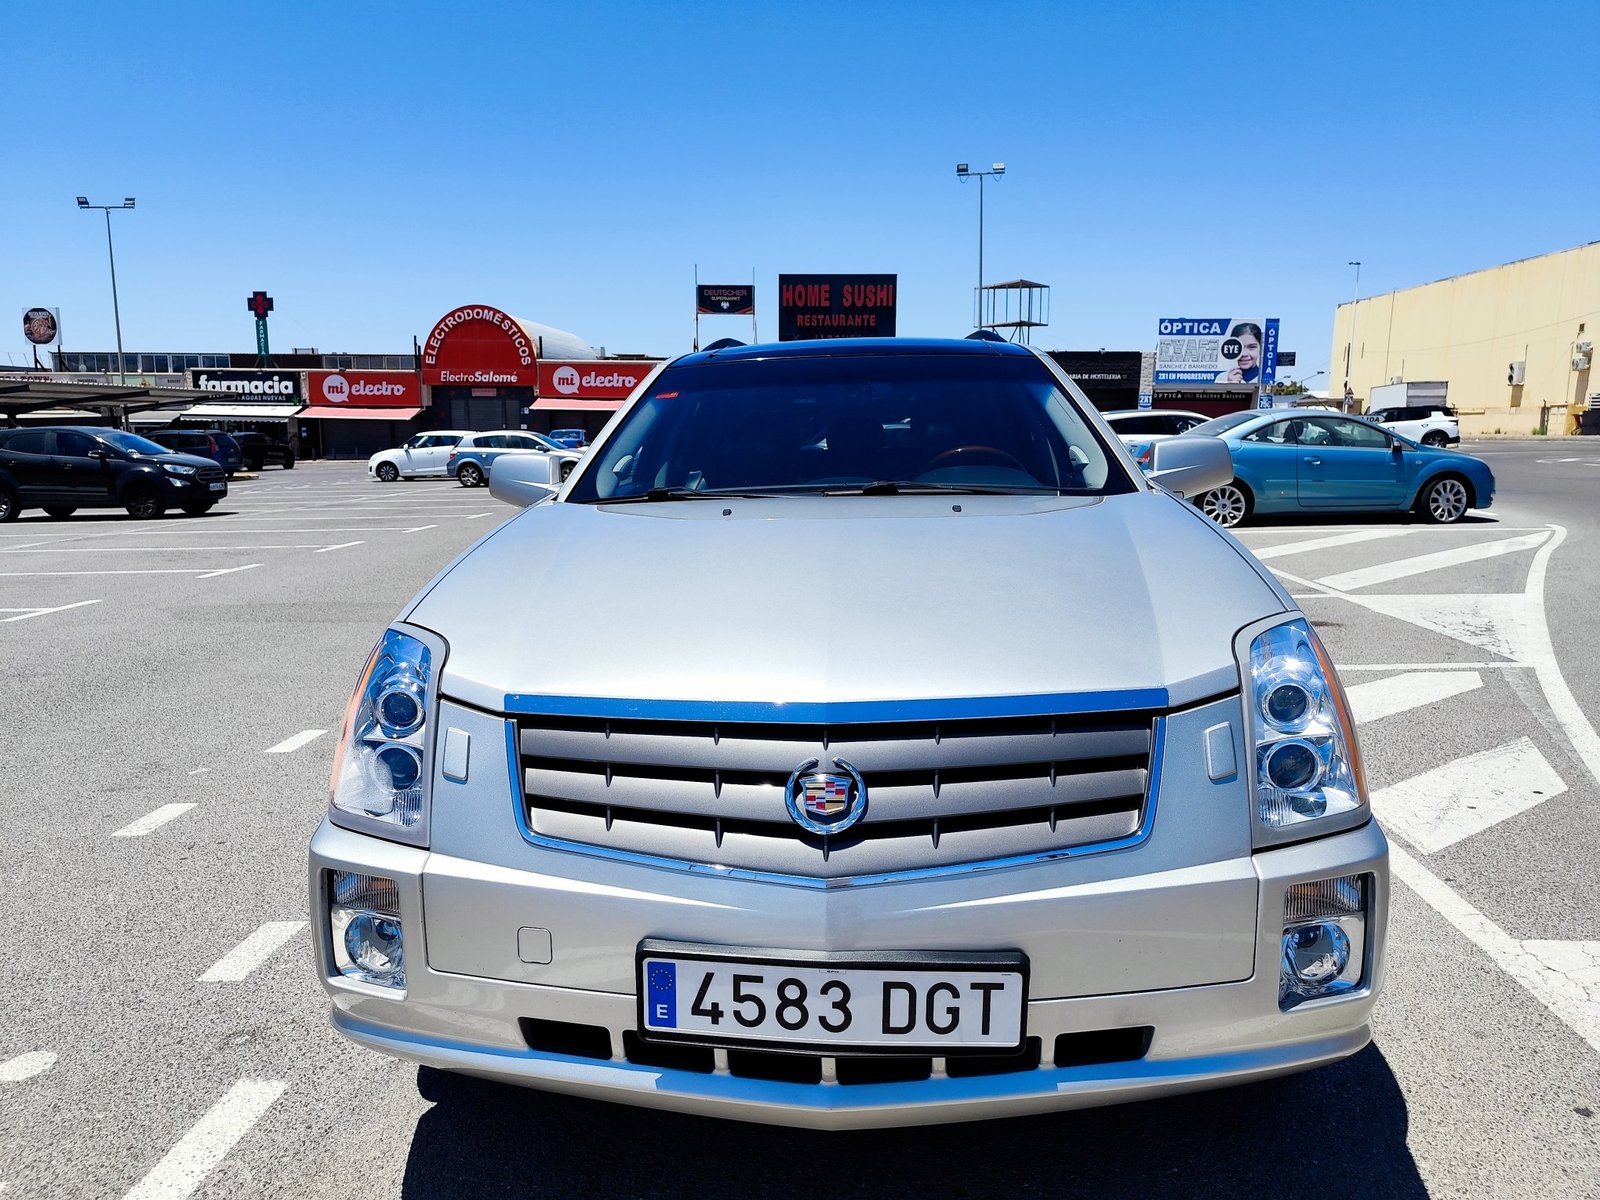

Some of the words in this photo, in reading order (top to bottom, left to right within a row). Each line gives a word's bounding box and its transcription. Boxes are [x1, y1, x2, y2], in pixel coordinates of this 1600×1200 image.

[703, 289, 747, 297] DEUTSCHER
[782, 284, 830, 307] HOME
[842, 284, 893, 308] SUSHI
[797, 314, 876, 326] RESTAURANTE
[1160, 320, 1222, 334] ÓPTICA
[258, 321, 266, 355] FARMACIA
[425, 308, 531, 366] ELECTRODOMÉSTICOS
[1223, 344, 1239, 355] EYE
[198, 375, 293, 394] farmacia
[440, 371, 518, 383] ElectroSalomé
[557, 374, 576, 386] mi
[582, 372, 637, 388] electro
[327, 383, 345, 394] mi
[351, 380, 406, 396] electro
[656, 1004, 668, 1018] E
[690, 972, 853, 1033] 4583
[881, 982, 1004, 1035] DGT
